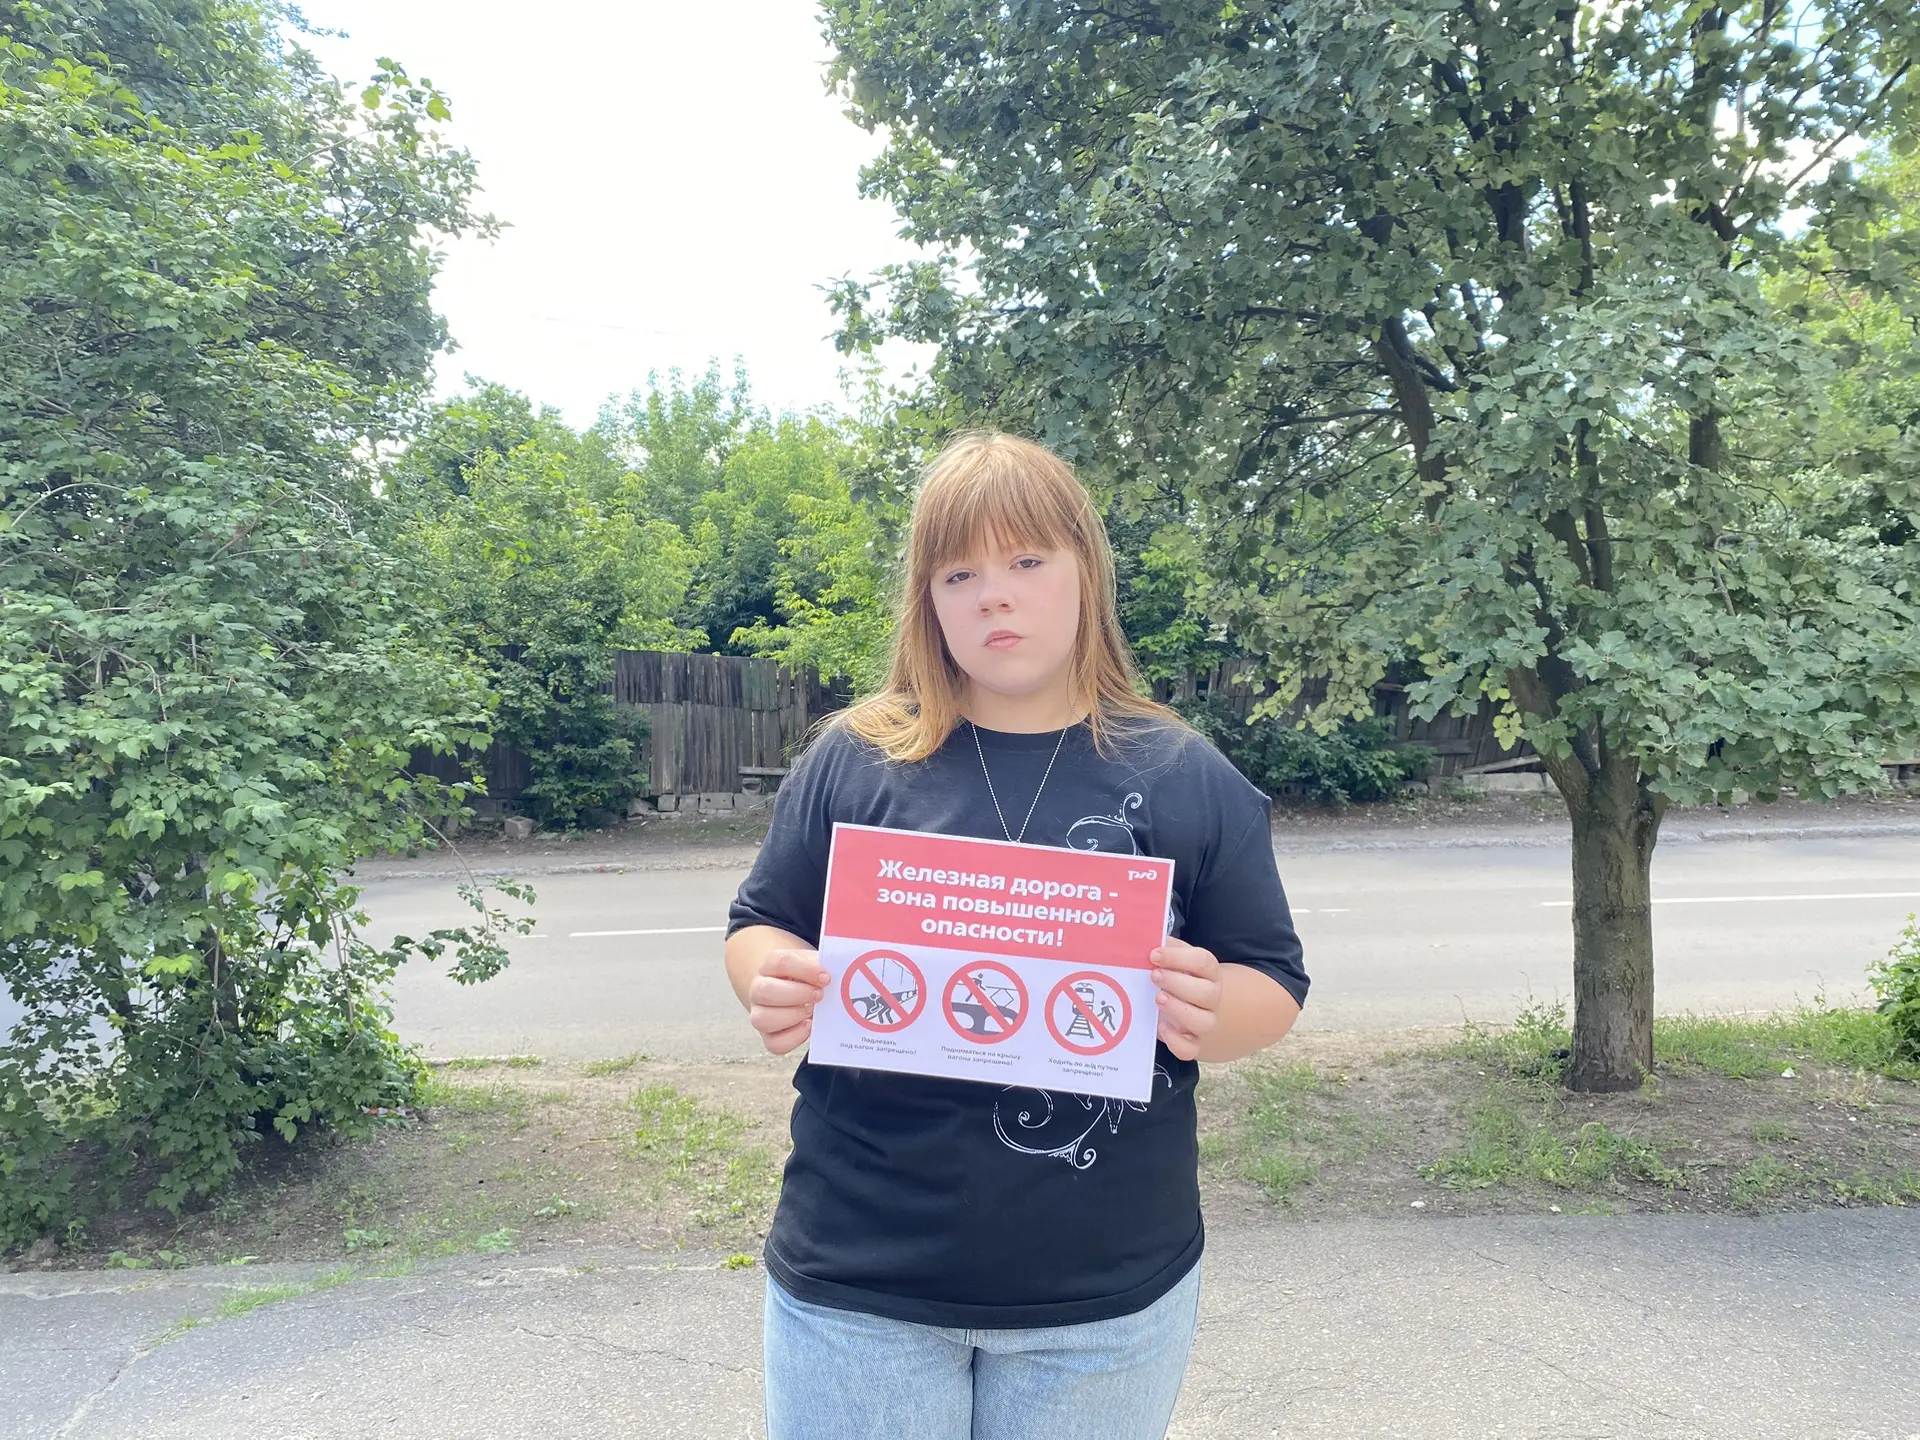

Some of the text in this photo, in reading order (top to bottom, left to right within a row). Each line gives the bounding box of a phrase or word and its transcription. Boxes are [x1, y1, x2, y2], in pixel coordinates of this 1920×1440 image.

[877, 859, 1006, 891] Железная
[1009, 876, 1102, 901] дорога
[876, 888, 1116, 927] зона повышенной
[920, 918, 1064, 947] опасности!
[839, 1042, 853, 1050] под
[854, 1043, 874, 1051] вагон
[861, 1036, 897, 1046] Подлезать
[941, 1045, 987, 1057] Подниматься
[996, 1052, 1022, 1061] крышу
[947, 1054, 971, 1062] вагона
[1048, 1057, 1073, 1066] Ходить
[1084, 1061, 1097, 1070] ж/д
